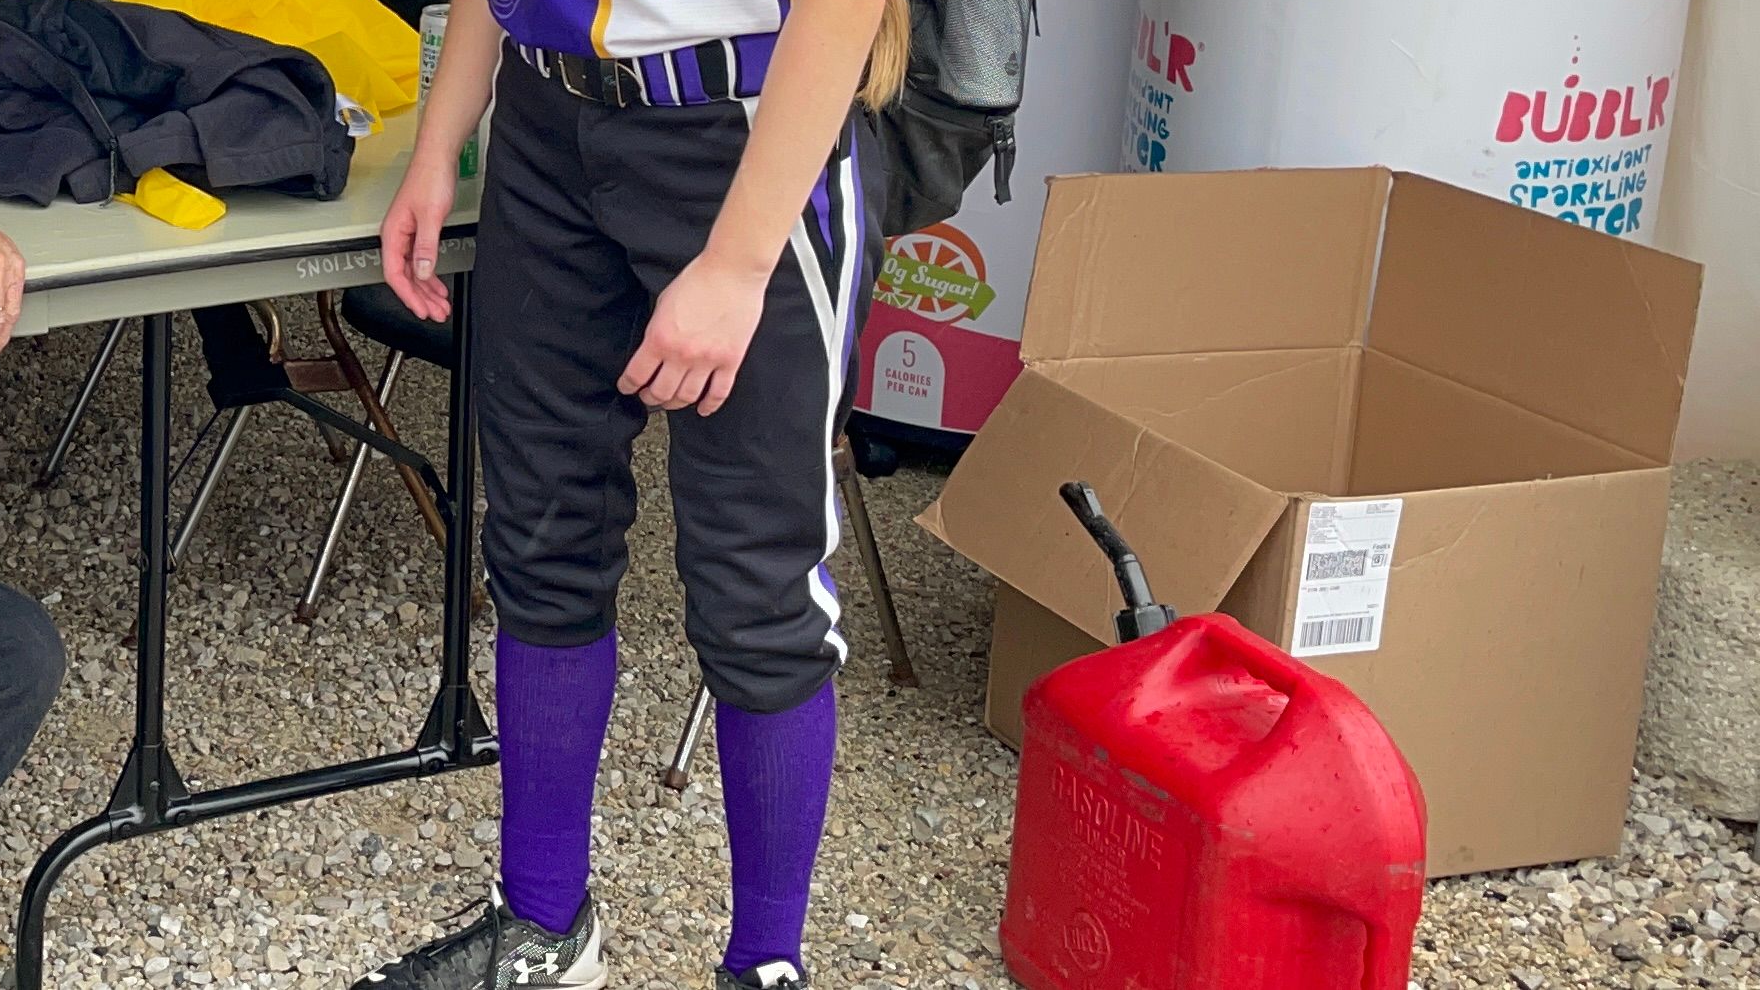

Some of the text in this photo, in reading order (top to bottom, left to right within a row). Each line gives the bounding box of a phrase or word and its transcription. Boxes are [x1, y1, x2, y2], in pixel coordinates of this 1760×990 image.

[911, 264, 979, 299] Sugar!
[901, 338, 917, 369] 5
[885, 368, 932, 387] CALORIES
[887, 380, 928, 398] PER CAN
[1052, 765, 1164, 870] GASOLINE
